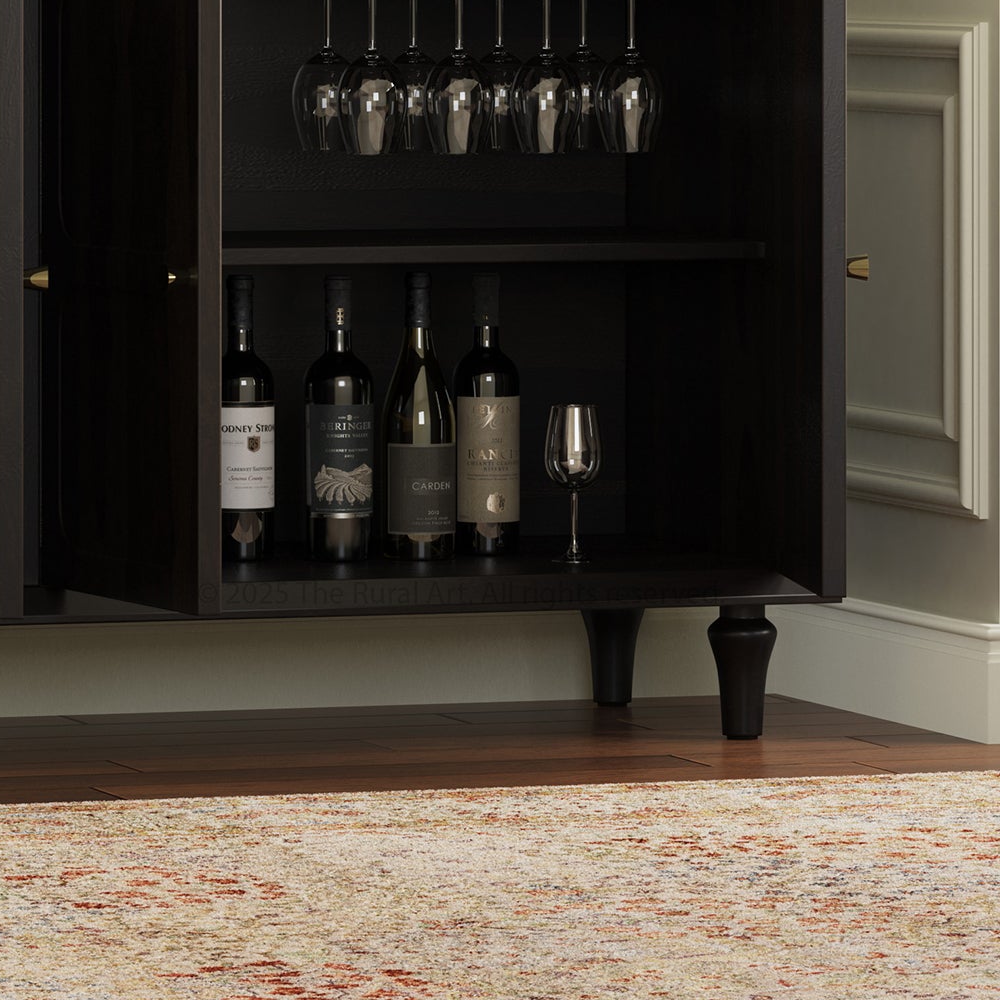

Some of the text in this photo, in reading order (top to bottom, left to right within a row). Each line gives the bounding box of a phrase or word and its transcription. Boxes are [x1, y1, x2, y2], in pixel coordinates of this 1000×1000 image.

[221, 423, 276, 433] ODNEY STRO
[319, 421, 372, 431] BERINGER
[411, 481, 450, 491] CARDEN
